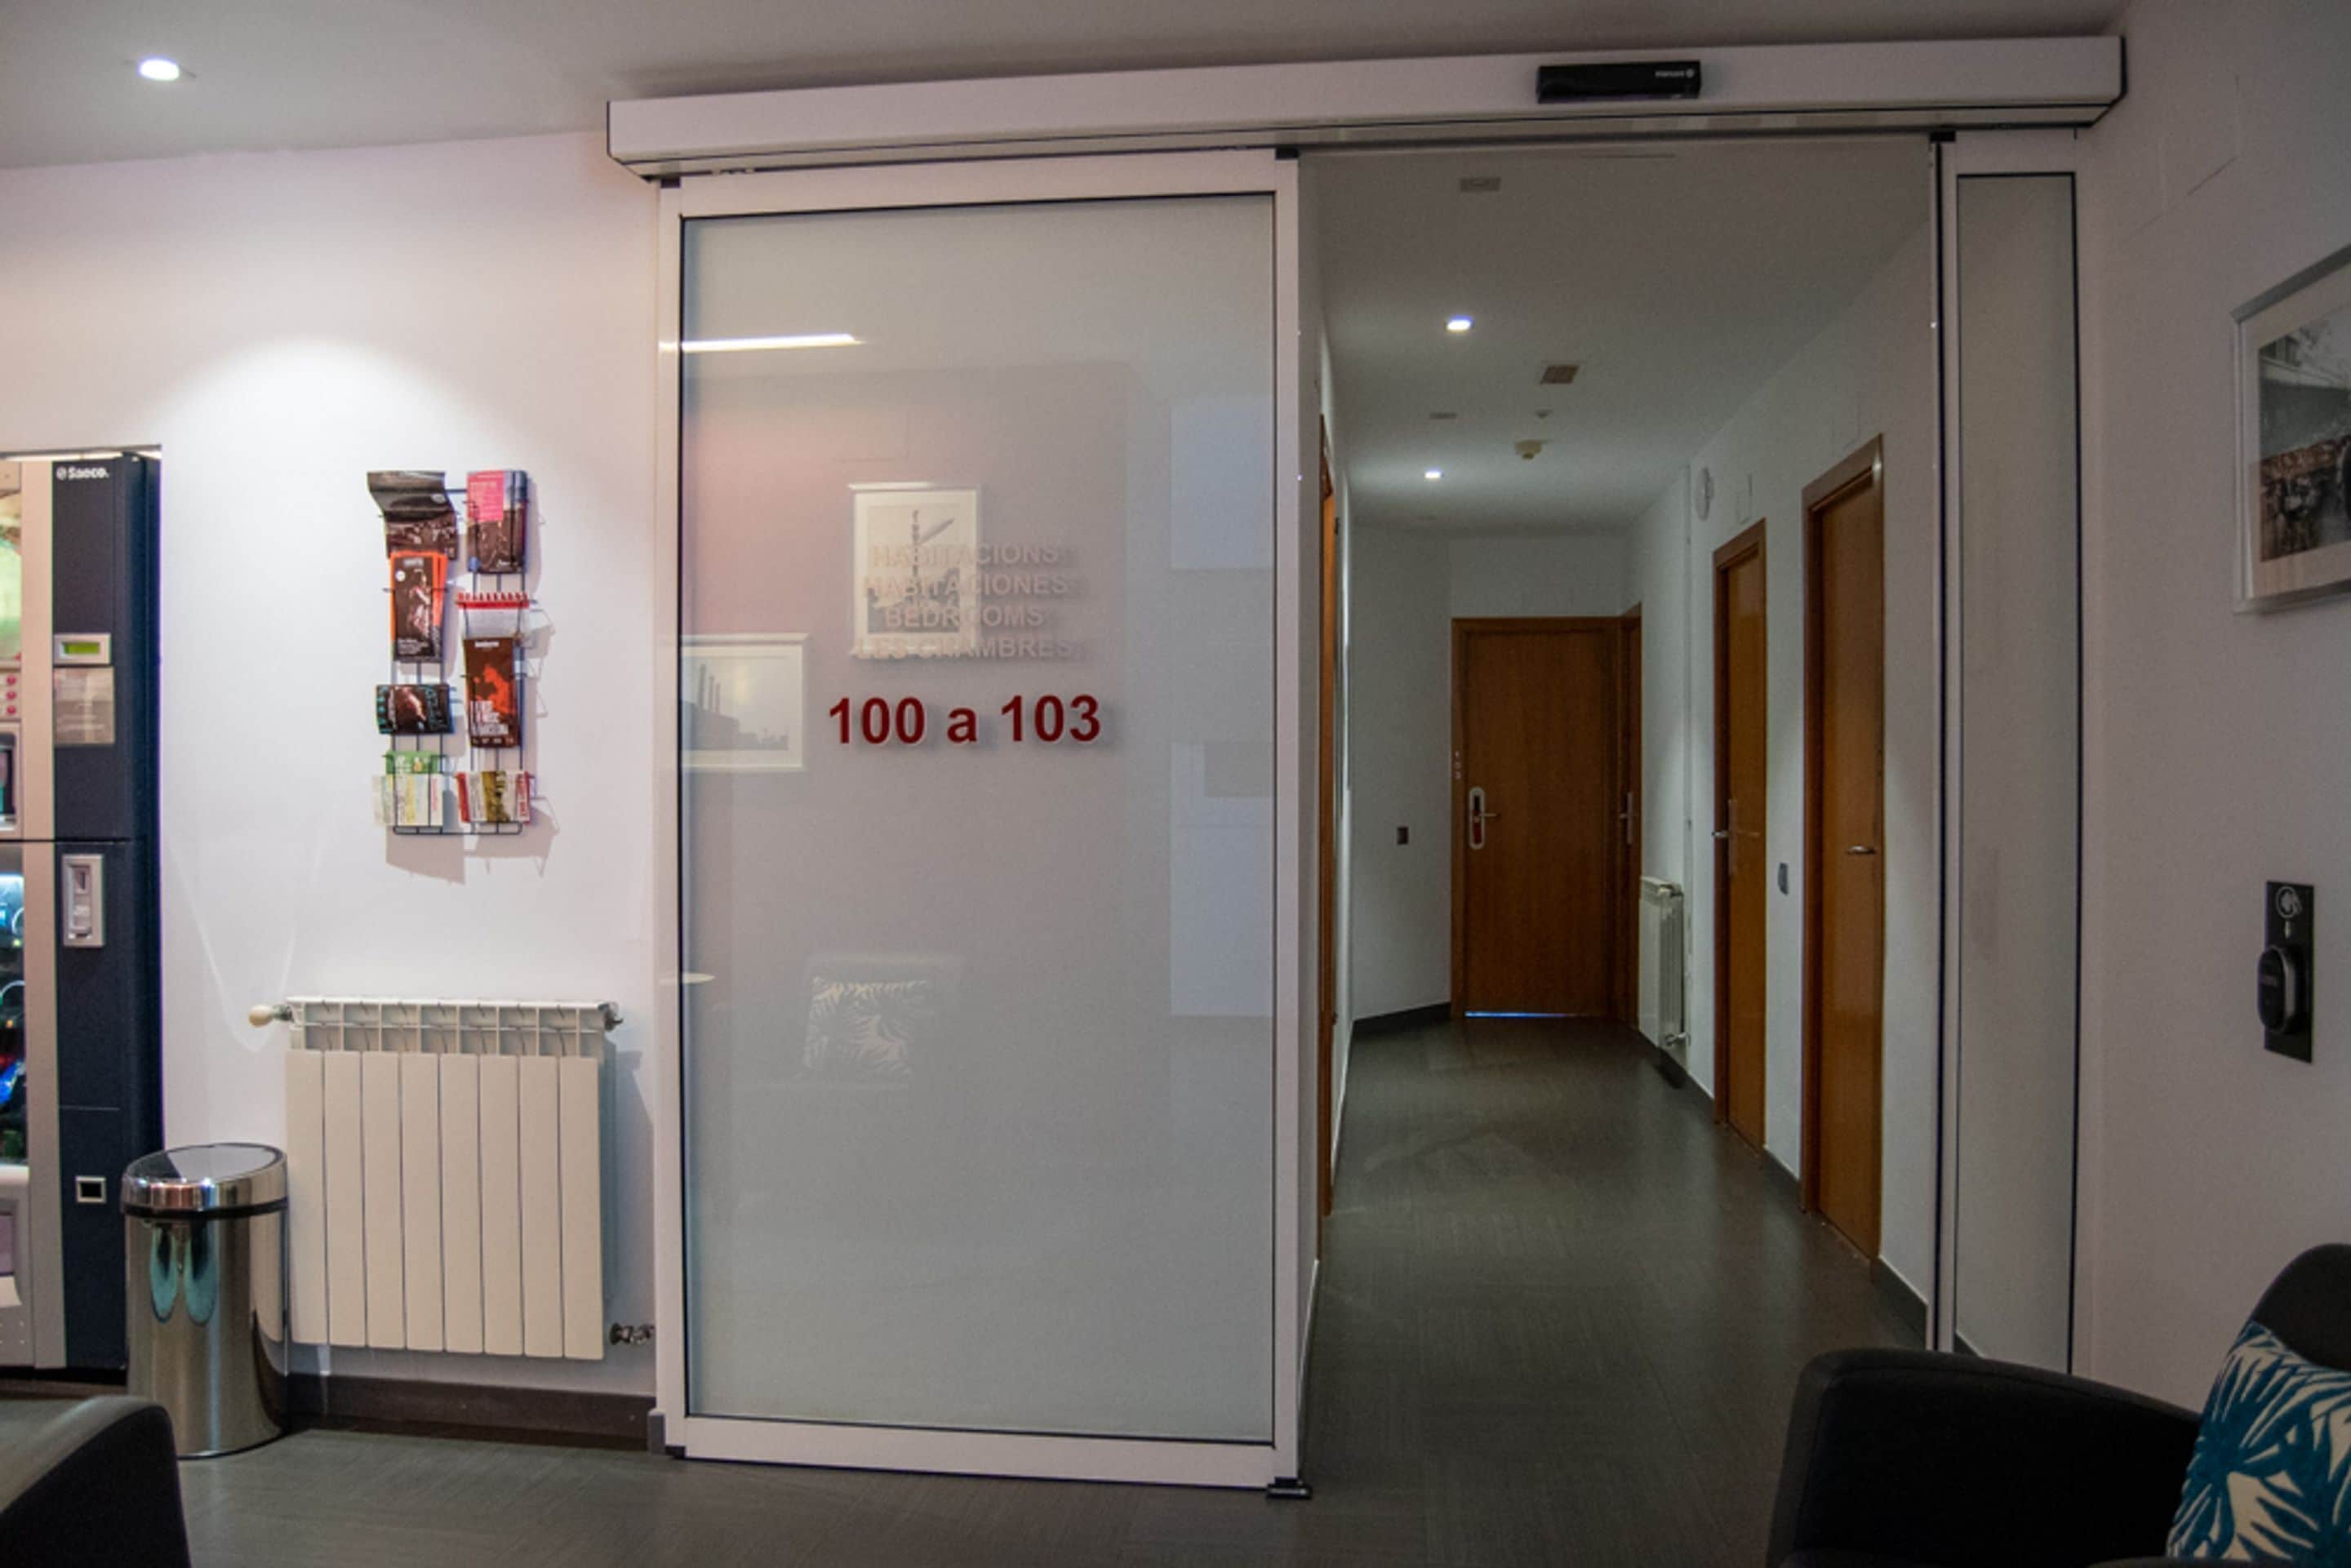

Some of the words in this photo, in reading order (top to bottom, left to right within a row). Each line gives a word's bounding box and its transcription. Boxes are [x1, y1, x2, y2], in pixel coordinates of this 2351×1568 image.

[829, 697, 926, 744] 100
[947, 707, 977, 743] a
[1001, 695, 1101, 742] 103
